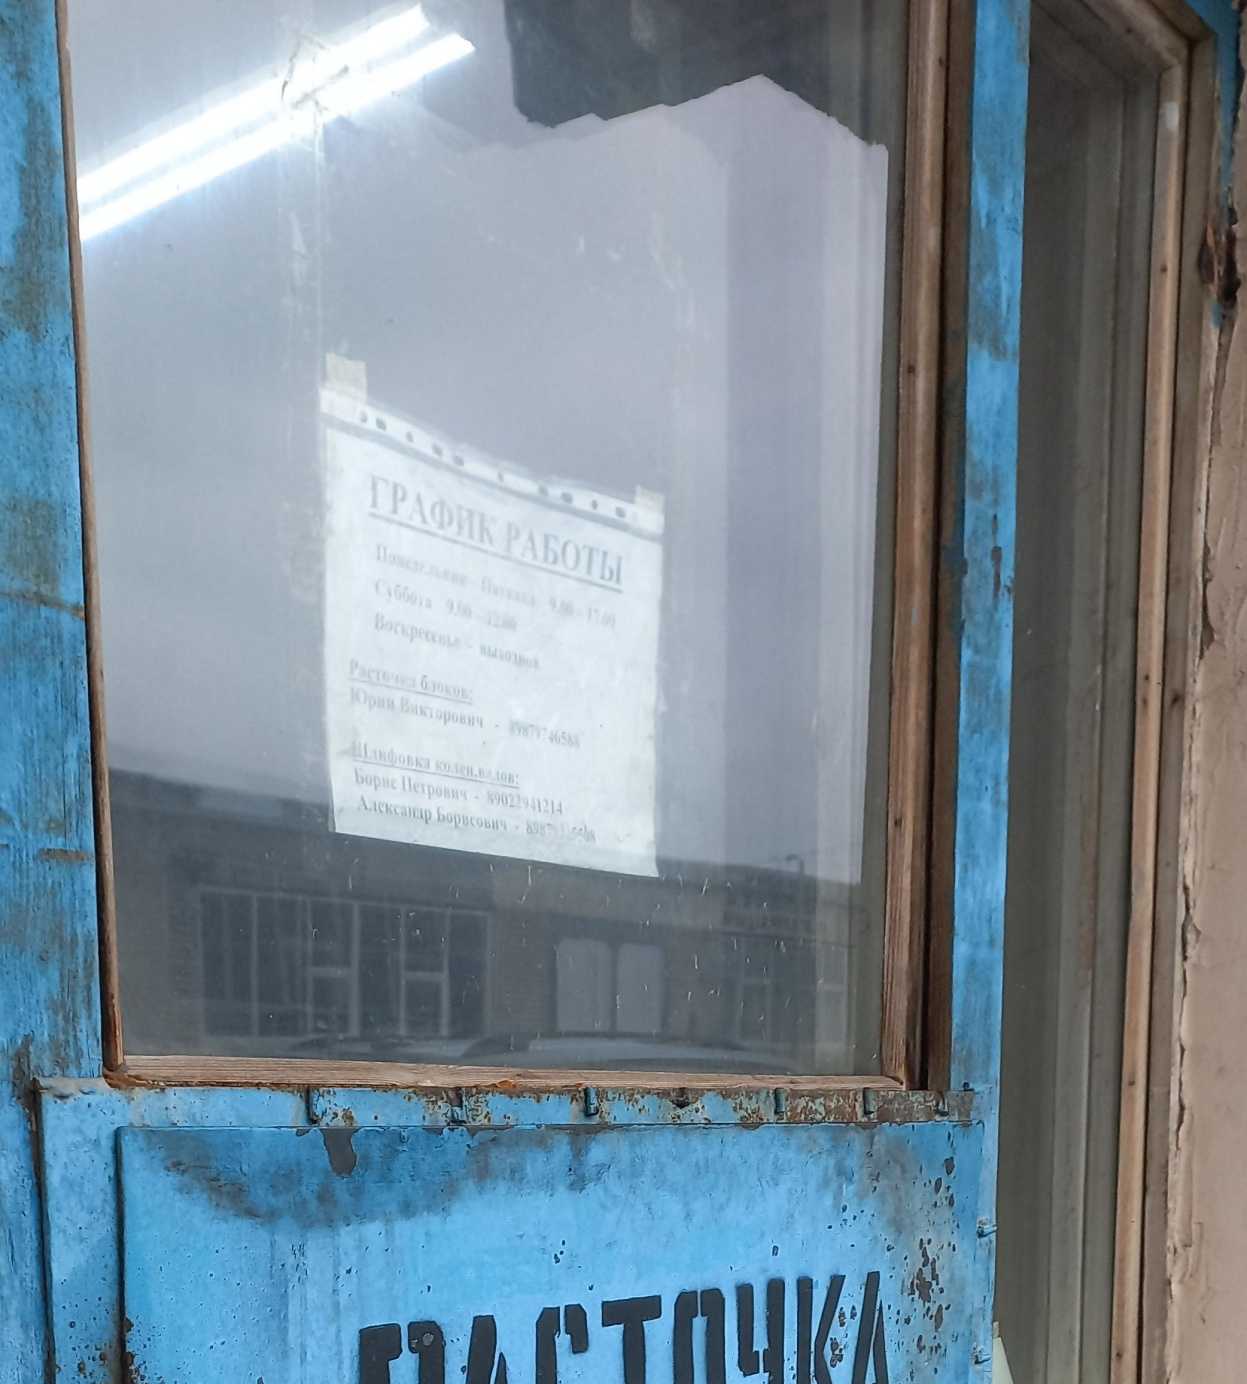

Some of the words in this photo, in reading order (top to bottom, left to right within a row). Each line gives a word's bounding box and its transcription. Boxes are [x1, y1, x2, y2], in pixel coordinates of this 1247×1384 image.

[369, 474, 494, 548] ГРАФИК
[506, 520, 624, 585] РАБОТЫ
[374, 578, 432, 610] Суббота
[420, 674, 473, 702] блоков:
[350, 687, 395, 713] Юрий
[400, 698, 484, 728] Викторович
[352, 741, 431, 771] Шлифовка
[354, 767, 397, 791] Борис
[402, 775, 468, 801] Петрович
[358, 794, 432, 825] Александр
[436, 806, 507, 832] Борисович
